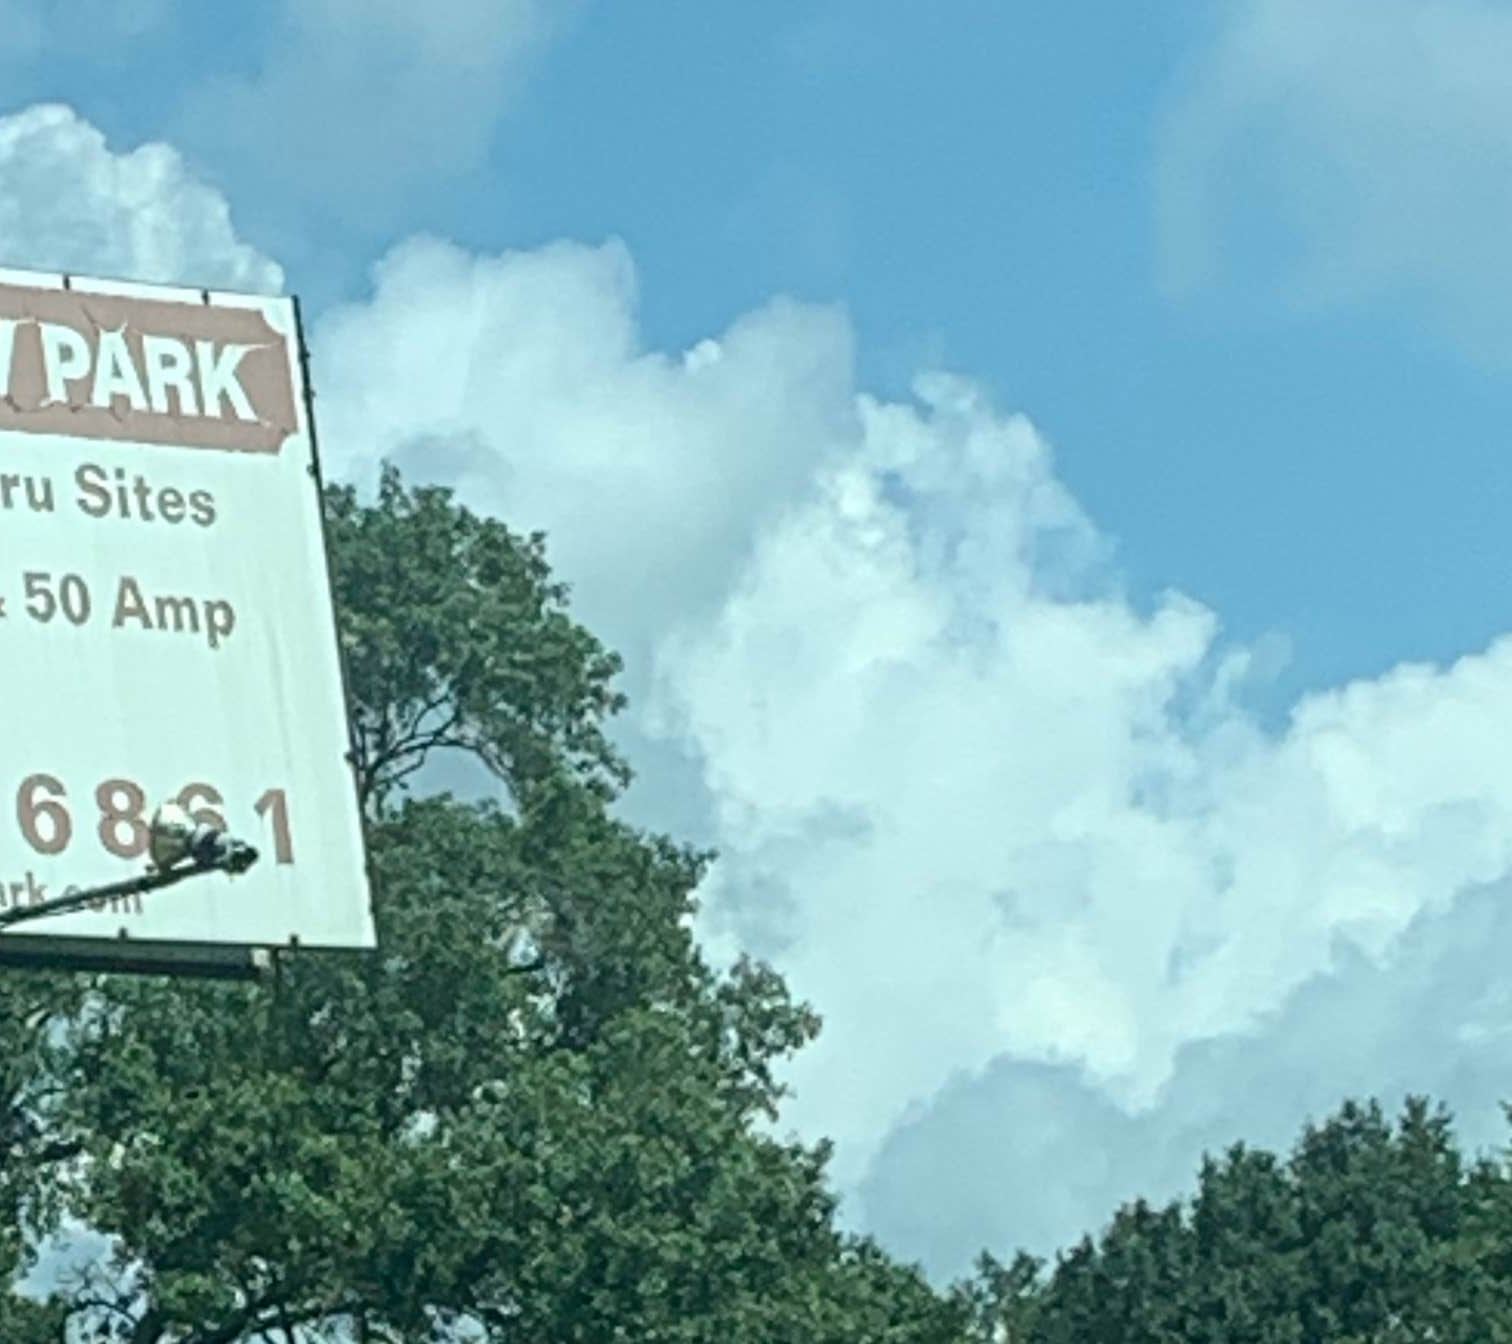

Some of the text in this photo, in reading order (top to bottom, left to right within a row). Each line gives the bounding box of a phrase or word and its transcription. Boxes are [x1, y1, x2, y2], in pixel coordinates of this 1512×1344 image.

[41, 322, 260, 425] PARK
[75, 463, 217, 528] Sites
[23, 571, 92, 627] 50
[112, 576, 236, 650] Amp
